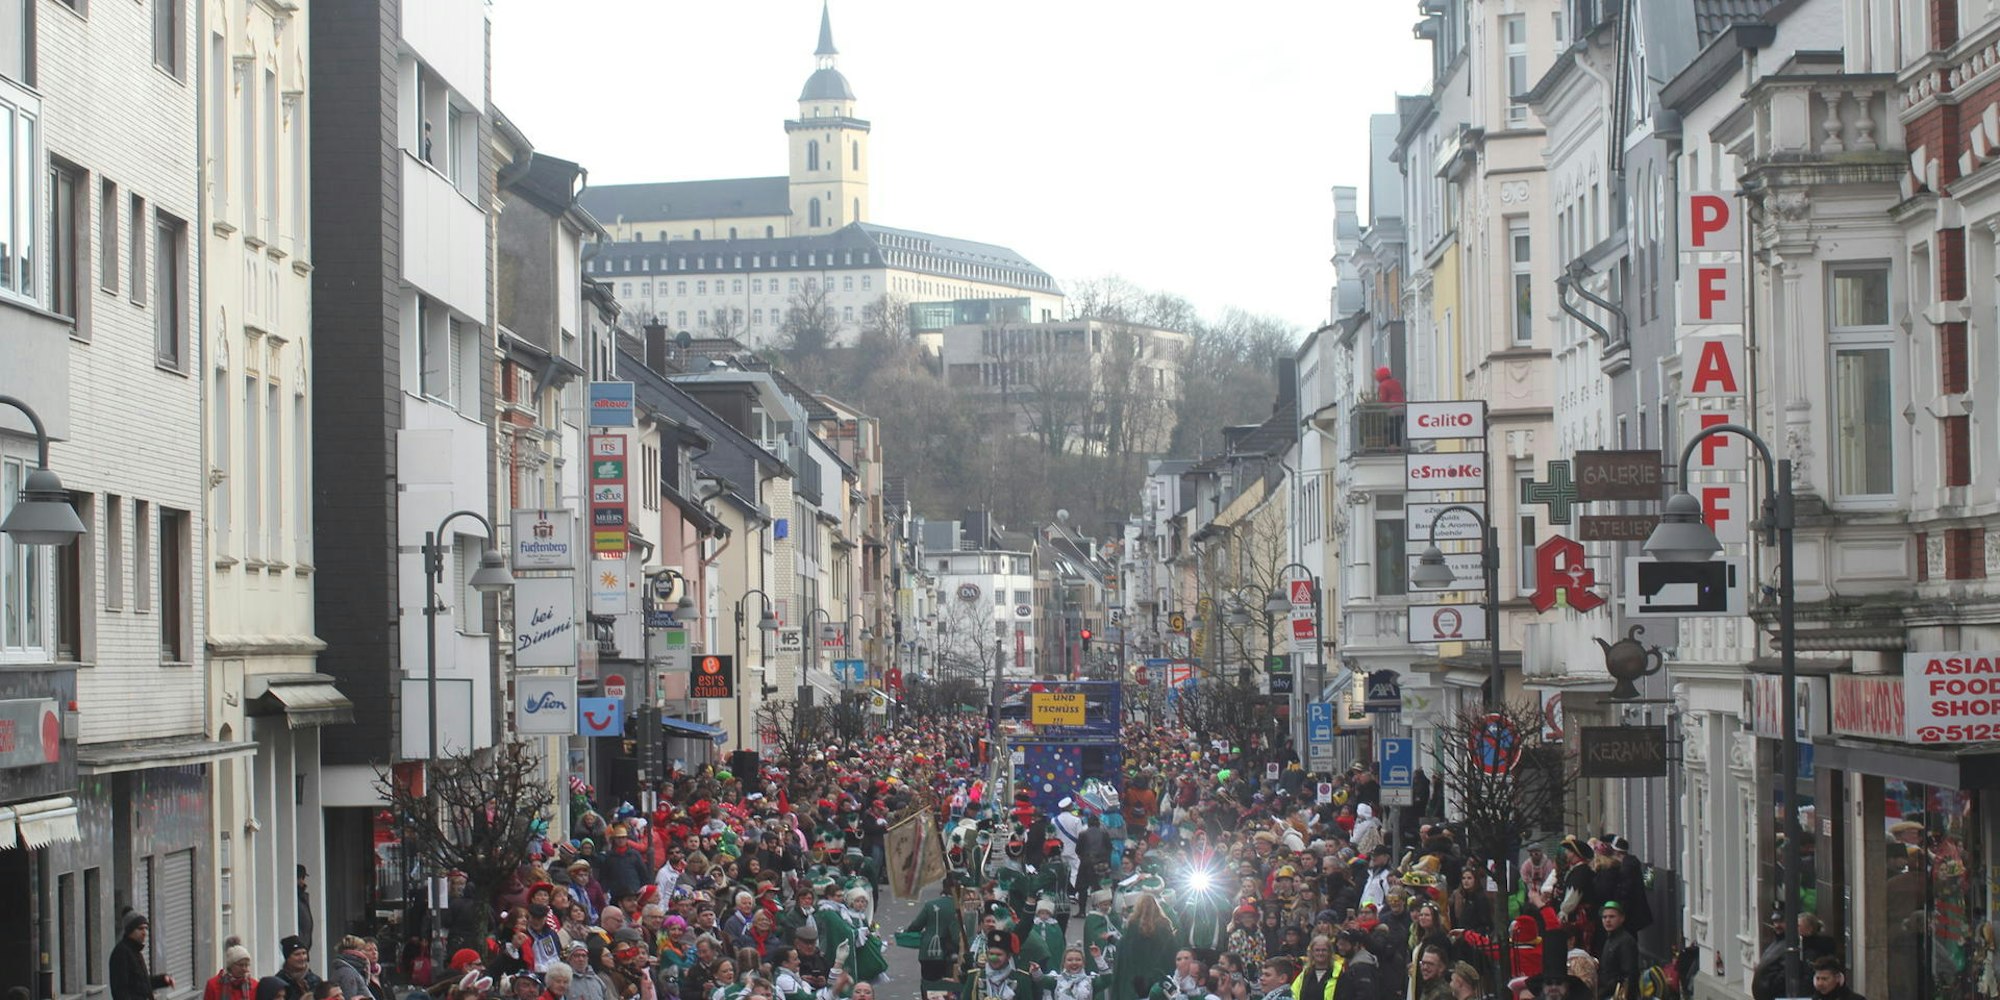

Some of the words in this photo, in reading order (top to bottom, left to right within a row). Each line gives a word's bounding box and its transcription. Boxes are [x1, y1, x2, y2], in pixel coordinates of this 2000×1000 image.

[1690, 195, 1742, 538] PFAFF
[600, 443, 616, 451] ITS
[1583, 463, 1657, 486] GALERIE
[1588, 520, 1653, 537] ATELIER
[531, 605, 553, 626] bei
[517, 617, 572, 652] Dimmi
[695, 687, 728, 697] STUDIO
[1272, 679, 1291, 690] sky
[1368, 683, 1397, 697] AXA
[1929, 677, 2000, 696] FOOD
[1311, 706, 1323, 722] P
[1864, 679, 1892, 735] FOOD
[1385, 741, 1400, 761] P
[1587, 740, 1661, 761] KERAMIK
